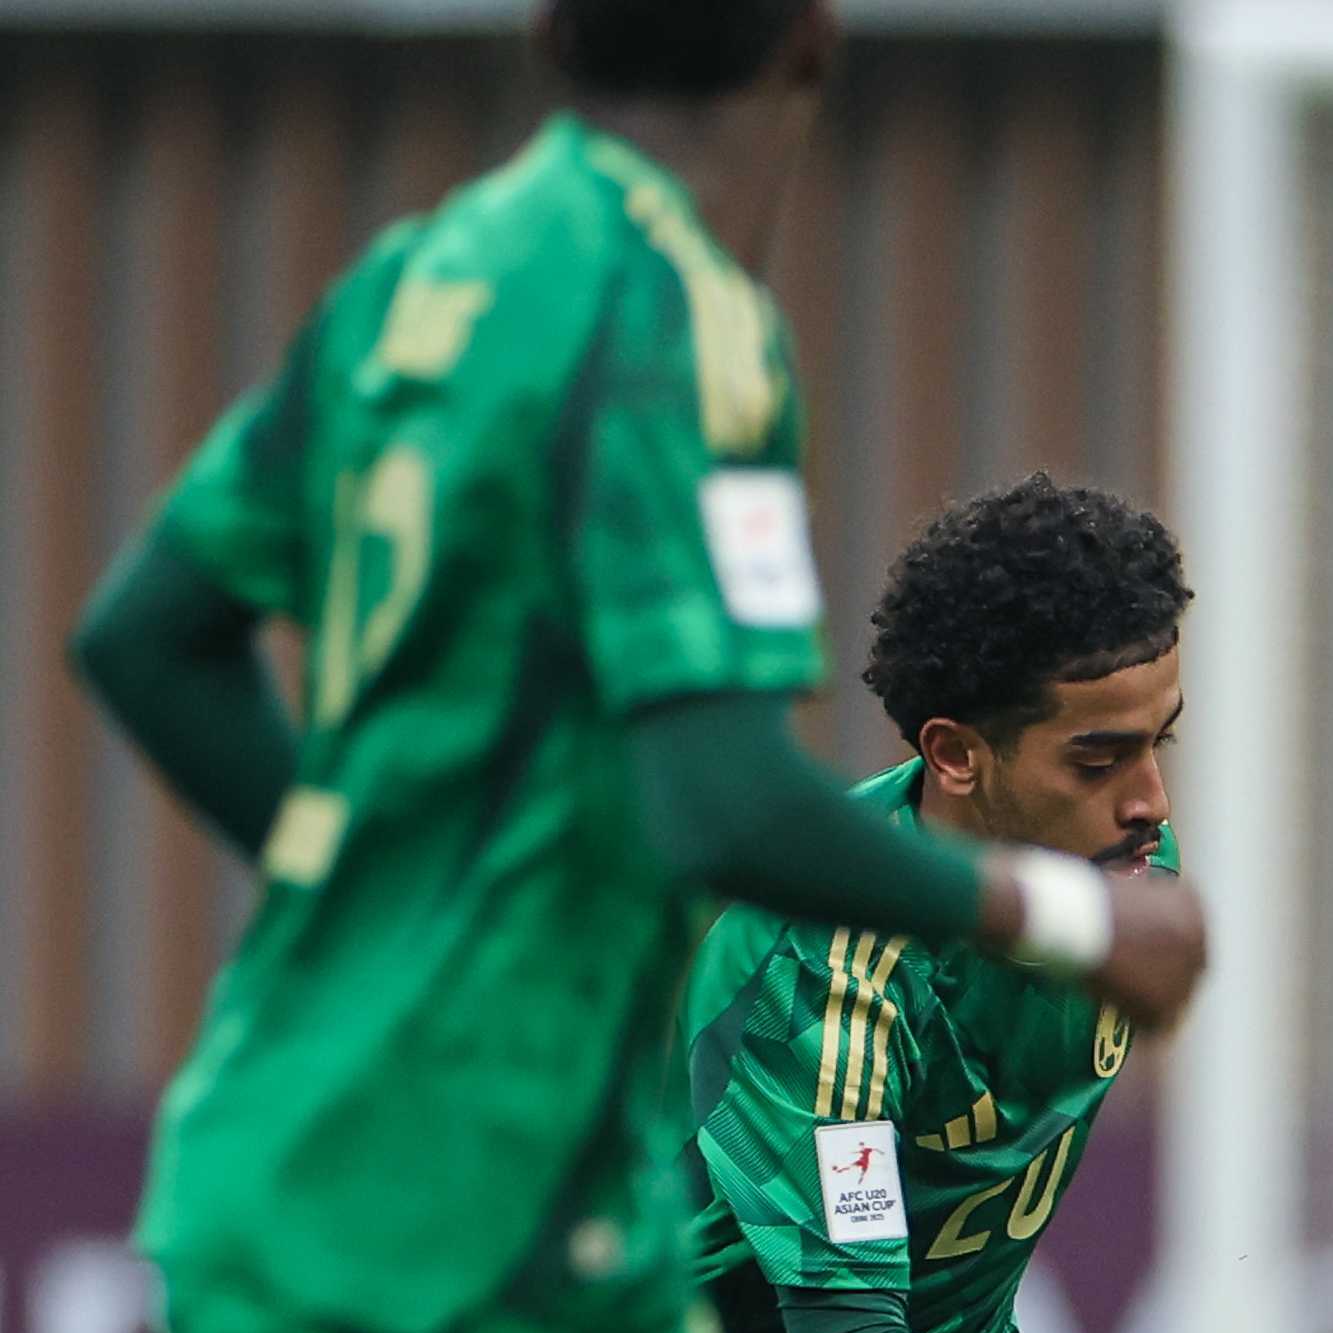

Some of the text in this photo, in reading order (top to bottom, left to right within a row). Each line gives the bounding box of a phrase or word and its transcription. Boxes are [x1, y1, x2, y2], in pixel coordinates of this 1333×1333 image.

[839, 1188, 887, 1202] AFC U20
[925, 1126, 1076, 1260] 20
[834, 1202, 871, 1215] ASIAN
